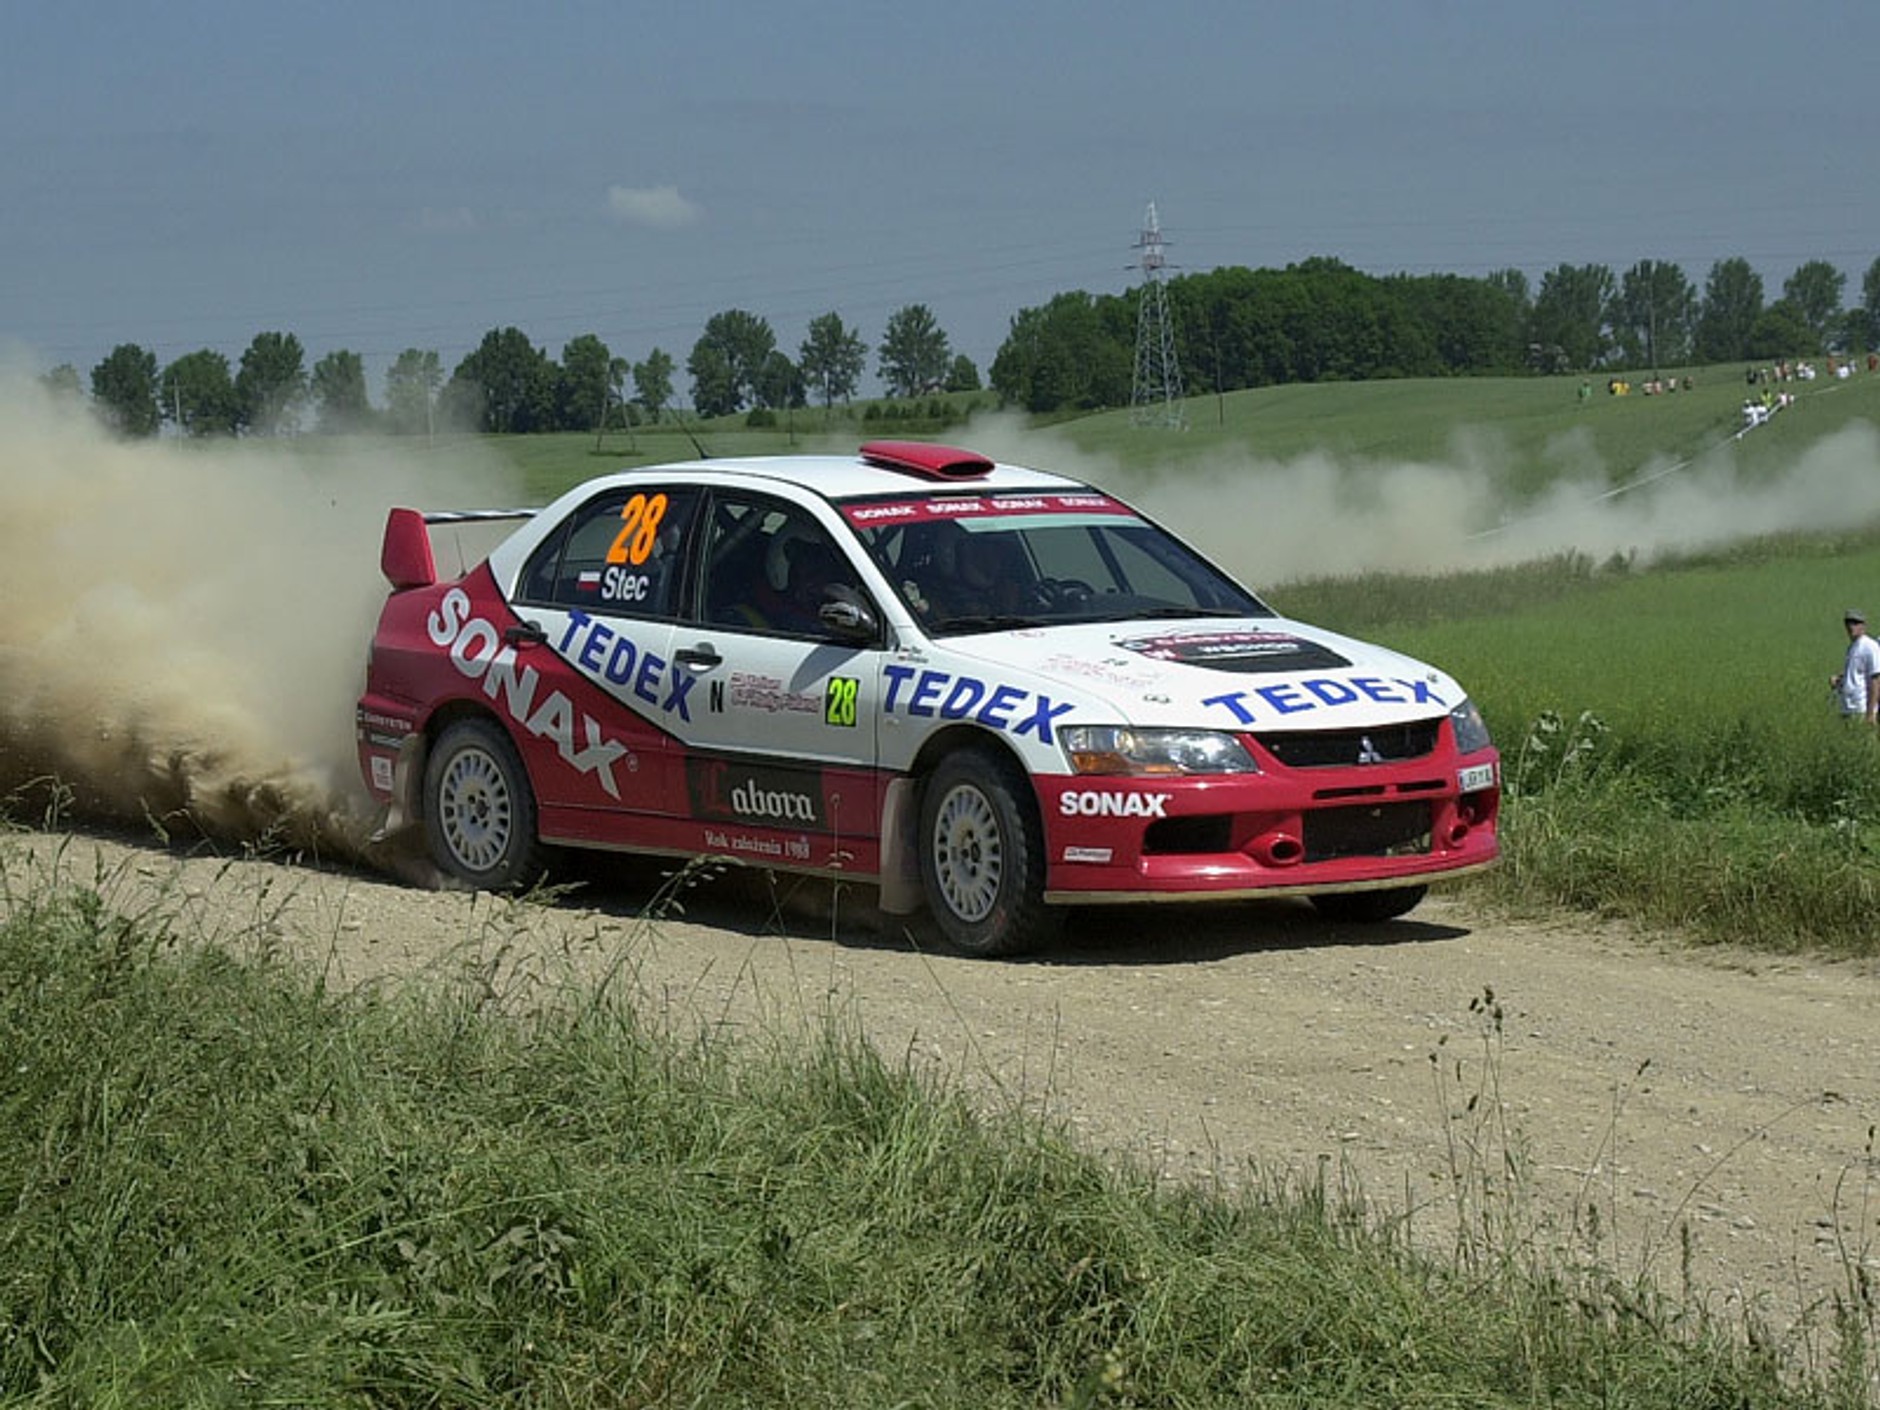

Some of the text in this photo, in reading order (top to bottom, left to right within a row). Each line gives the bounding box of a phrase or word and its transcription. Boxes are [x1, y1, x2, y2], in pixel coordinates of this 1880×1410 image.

[605, 493, 668, 565] 28
[602, 567, 649, 601] Stec
[559, 609, 698, 723] TEDEX
[428, 588, 629, 800] SONAX
[710, 680, 724, 713] N
[827, 678, 857, 726] 28
[883, 665, 1075, 746] TEDEX
[1202, 677, 1446, 726] TEDEX
[1060, 791, 1167, 817] SONAX
